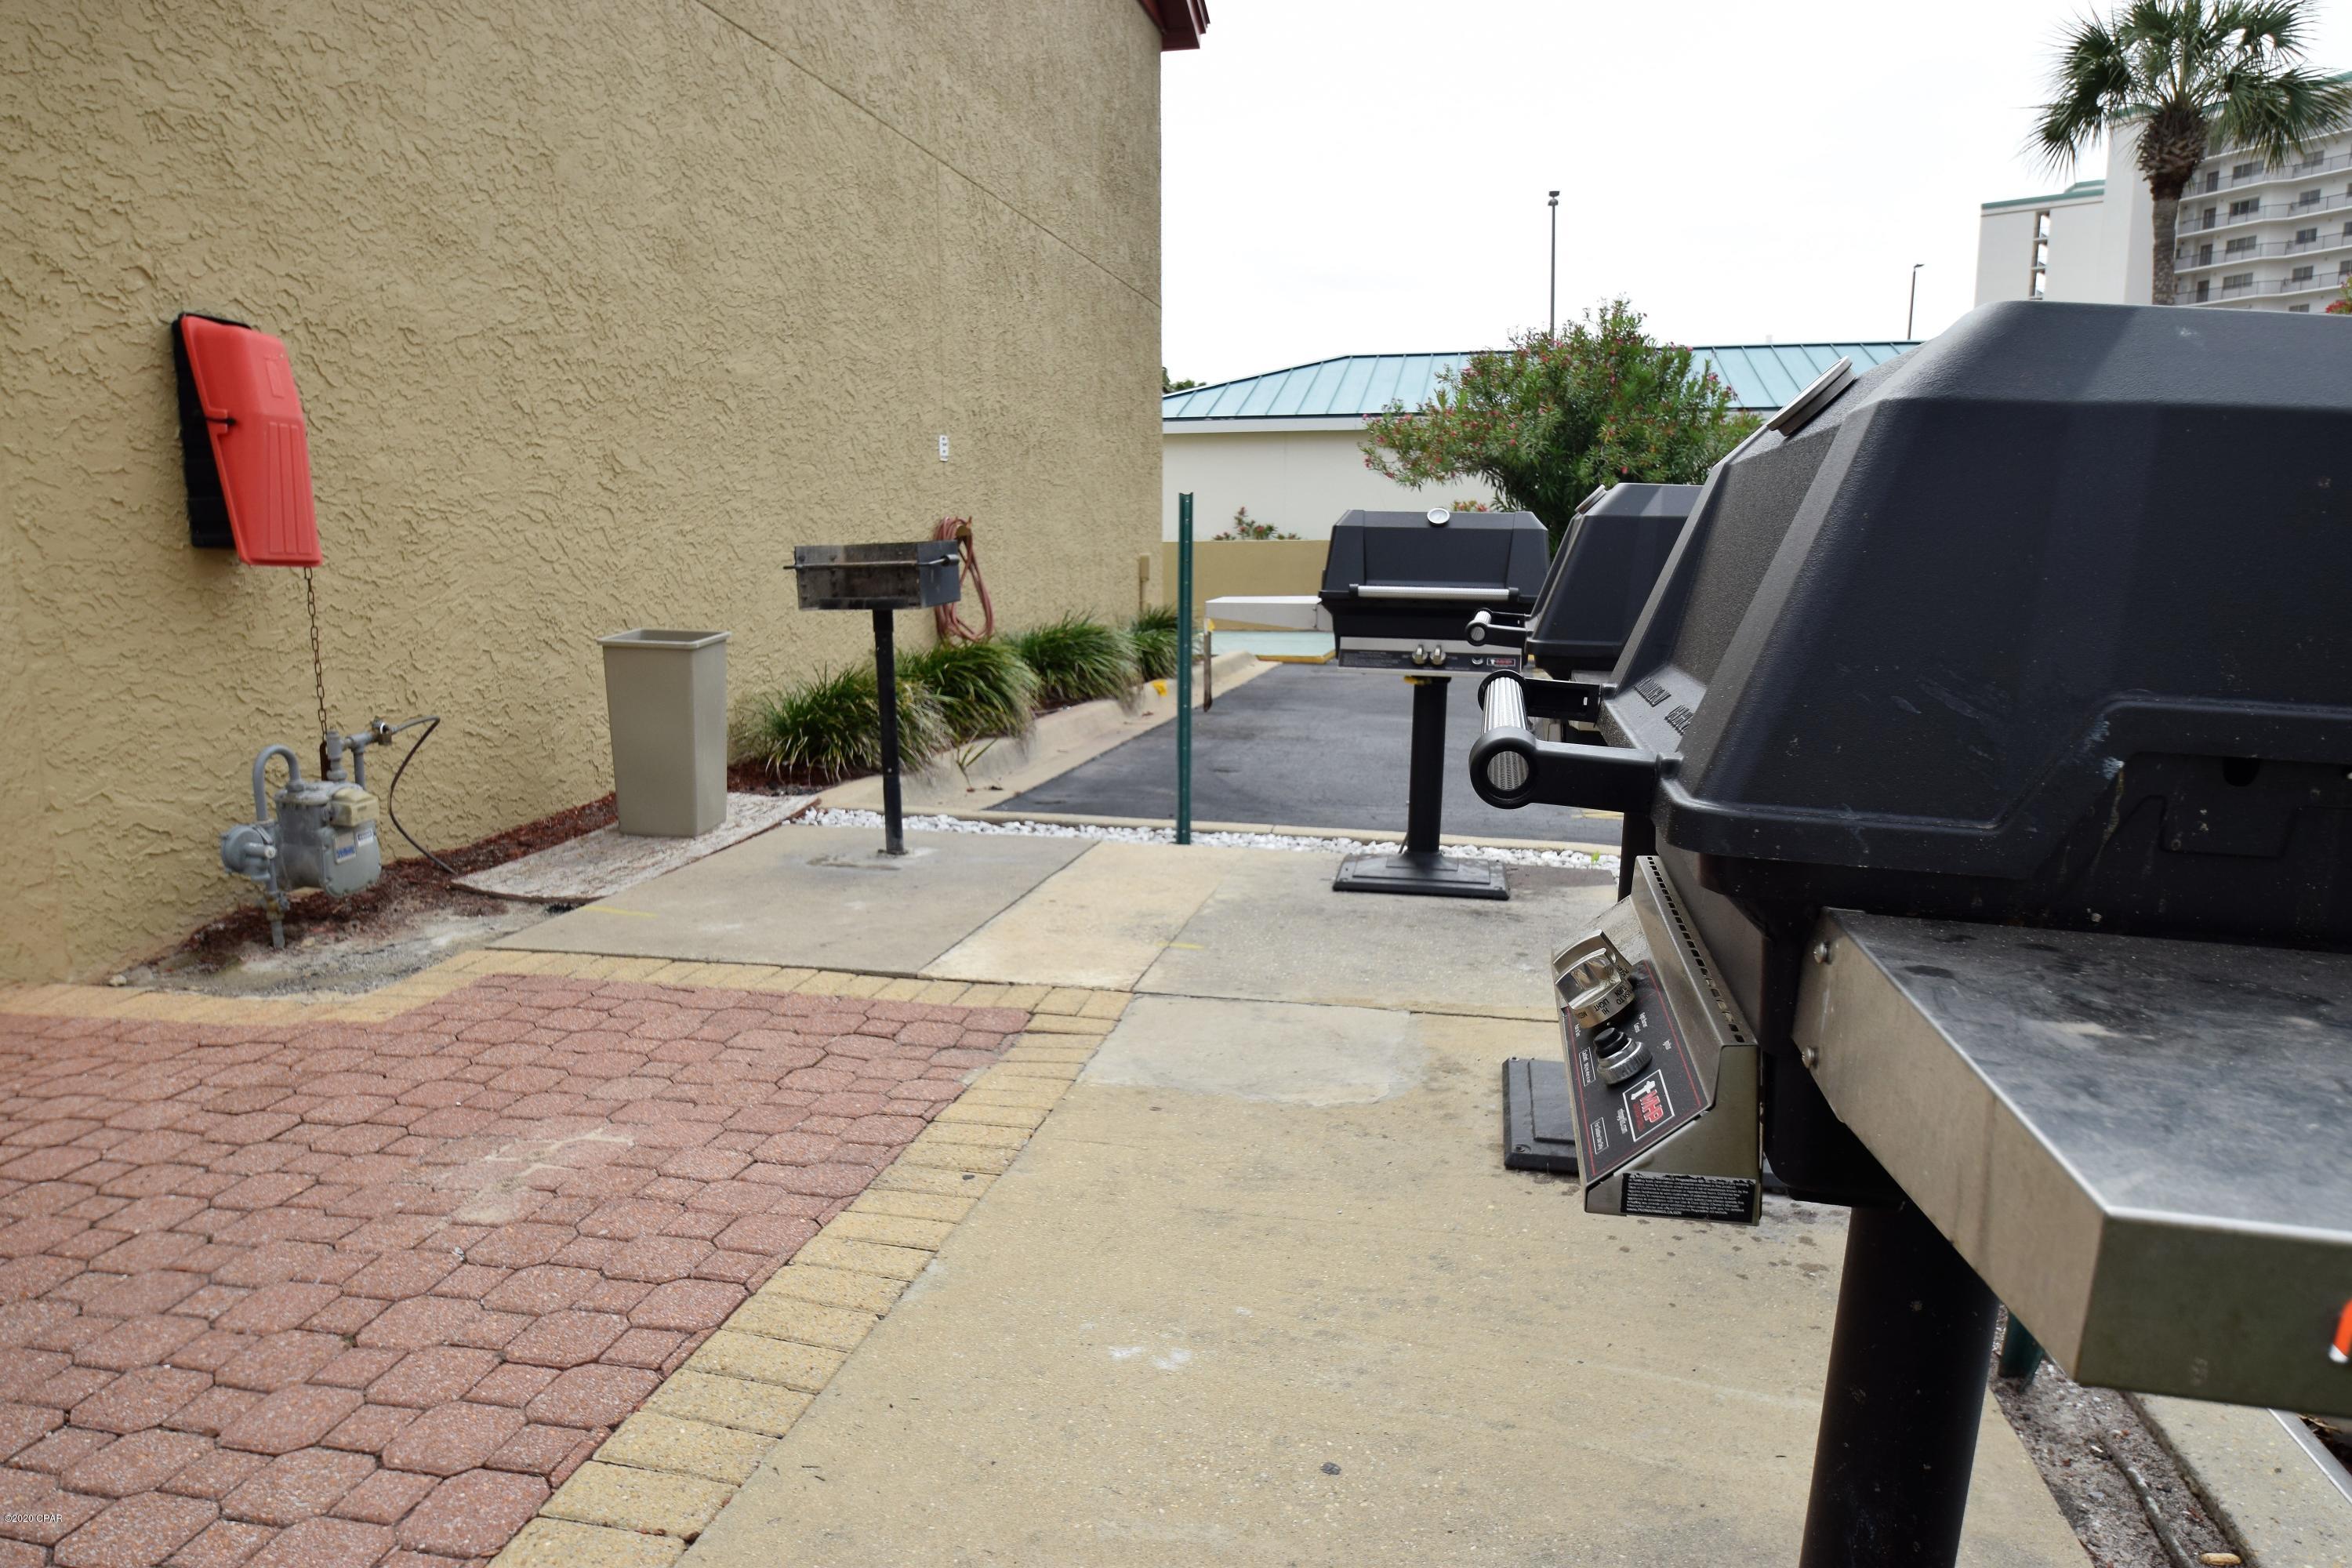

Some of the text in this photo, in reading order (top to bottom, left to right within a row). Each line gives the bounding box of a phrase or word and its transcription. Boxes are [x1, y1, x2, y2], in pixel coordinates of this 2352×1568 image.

[1594, 998, 1610, 1011] LIGHT
[1602, 1007, 1610, 1015] HI
[1639, 1089, 1664, 1123] MHP
